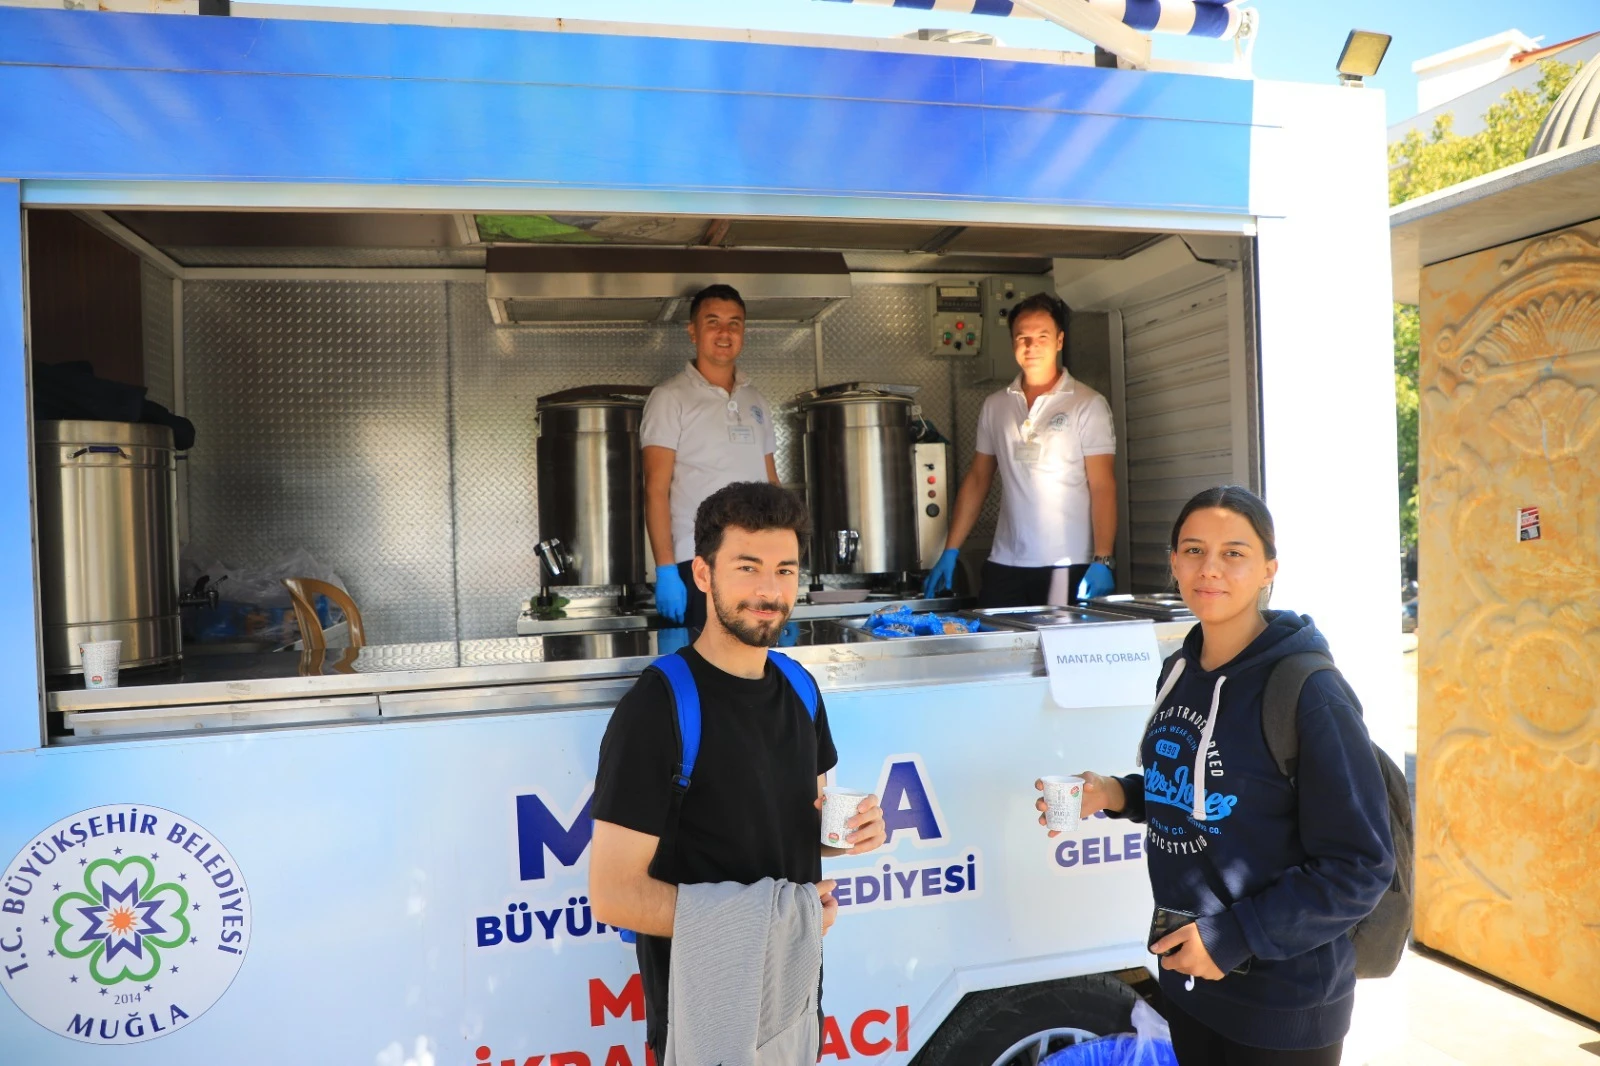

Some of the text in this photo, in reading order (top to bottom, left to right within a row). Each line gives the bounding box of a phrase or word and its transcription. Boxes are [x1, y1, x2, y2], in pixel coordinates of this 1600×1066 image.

[1056, 652, 1150, 665] MANTAR ÇORBASI
[1158, 742, 1177, 757] 1990
[1177, 705, 1224, 777] TRADERKED
[1055, 833, 1148, 868] GELE
[0, 808, 245, 980] T.C. BÜYÜKŞEHİR BELEDİYESİ
[830, 854, 976, 907] EDİYESİ
[113, 992, 142, 1006] 2014
[66, 1003, 190, 1040] MUĞLA
[816, 1005, 909, 1063] ACI
